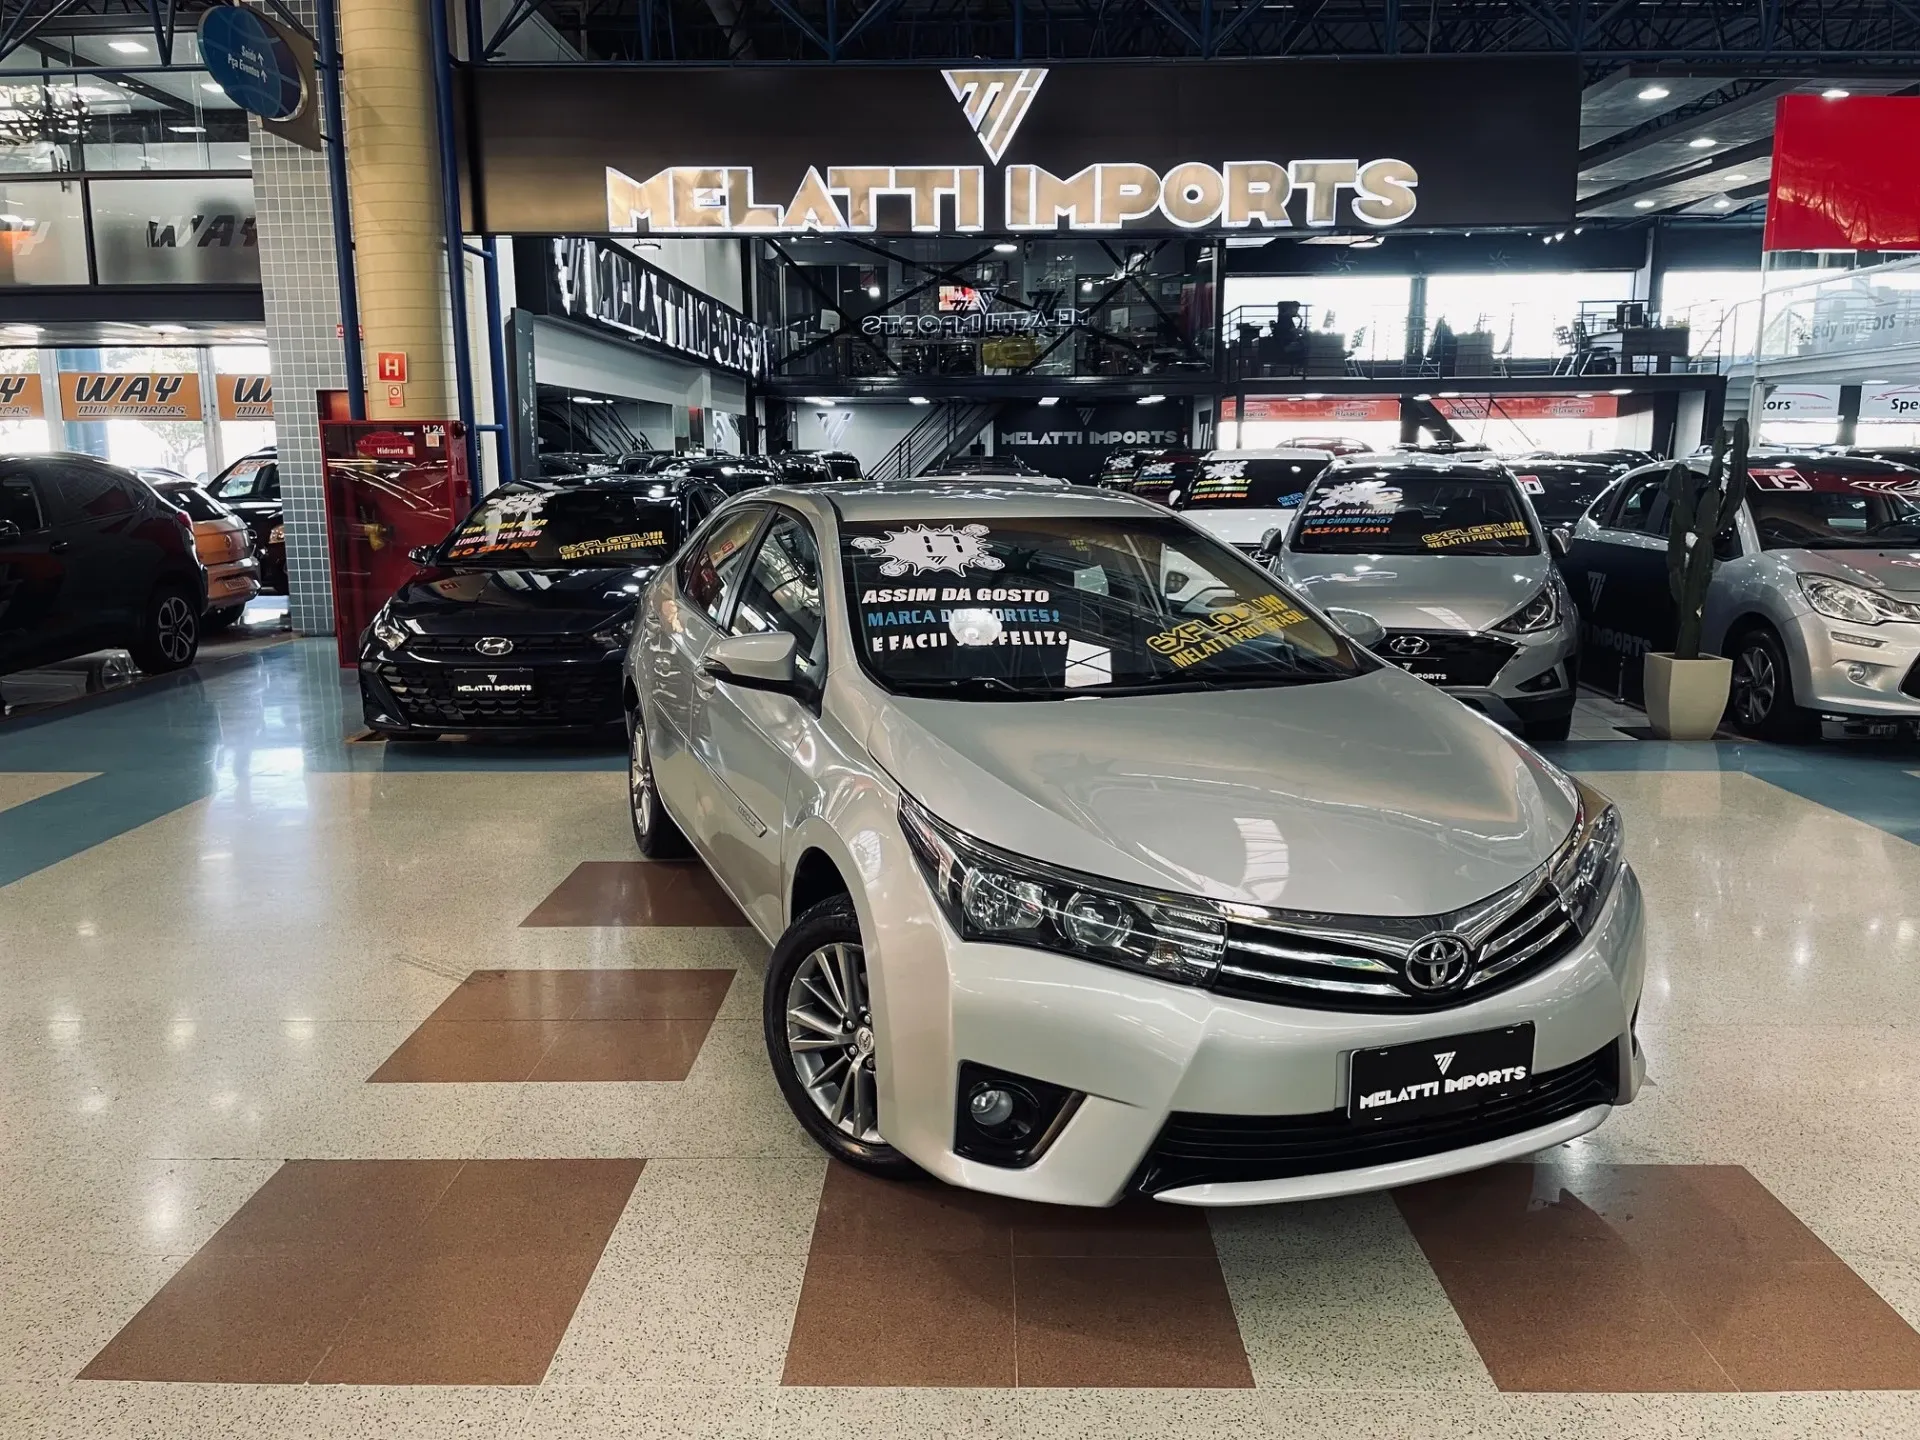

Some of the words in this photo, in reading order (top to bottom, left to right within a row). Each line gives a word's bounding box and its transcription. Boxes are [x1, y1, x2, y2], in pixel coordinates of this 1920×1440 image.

[605, 165, 984, 233] MELATTI
[1004, 158, 1419, 231] IMPORTS
[384, 358, 400, 377] H
[75, 375, 182, 403] WAY
[432, 424, 445, 434] 24
[1001, 431, 1083, 445] MELATTI
[1089, 430, 1178, 445] IMPORTS
[376, 446, 404, 455] Hidrante
[1427, 537, 1471, 549] MELATTI
[1494, 529, 1532, 539] BRASIL
[561, 547, 606, 560] MELATTI
[630, 538, 667, 549] BRASIL
[861, 588, 937, 604] ASSIM
[941, 588, 972, 601] DA
[976, 588, 1050, 603] GOSTO
[867, 609, 937, 628] MARCA
[1169, 634, 1237, 669] MELATTI
[1230, 623, 1265, 643] PRO
[1259, 610, 1309, 632] BRASIL
[1414, 672, 1447, 680] PORTS
[457, 684, 493, 692] MELATTI
[493, 684, 532, 692] IMPORTS
[1359, 1080, 1439, 1110] MELATTI
[1444, 1065, 1527, 1094] IMPORTS
